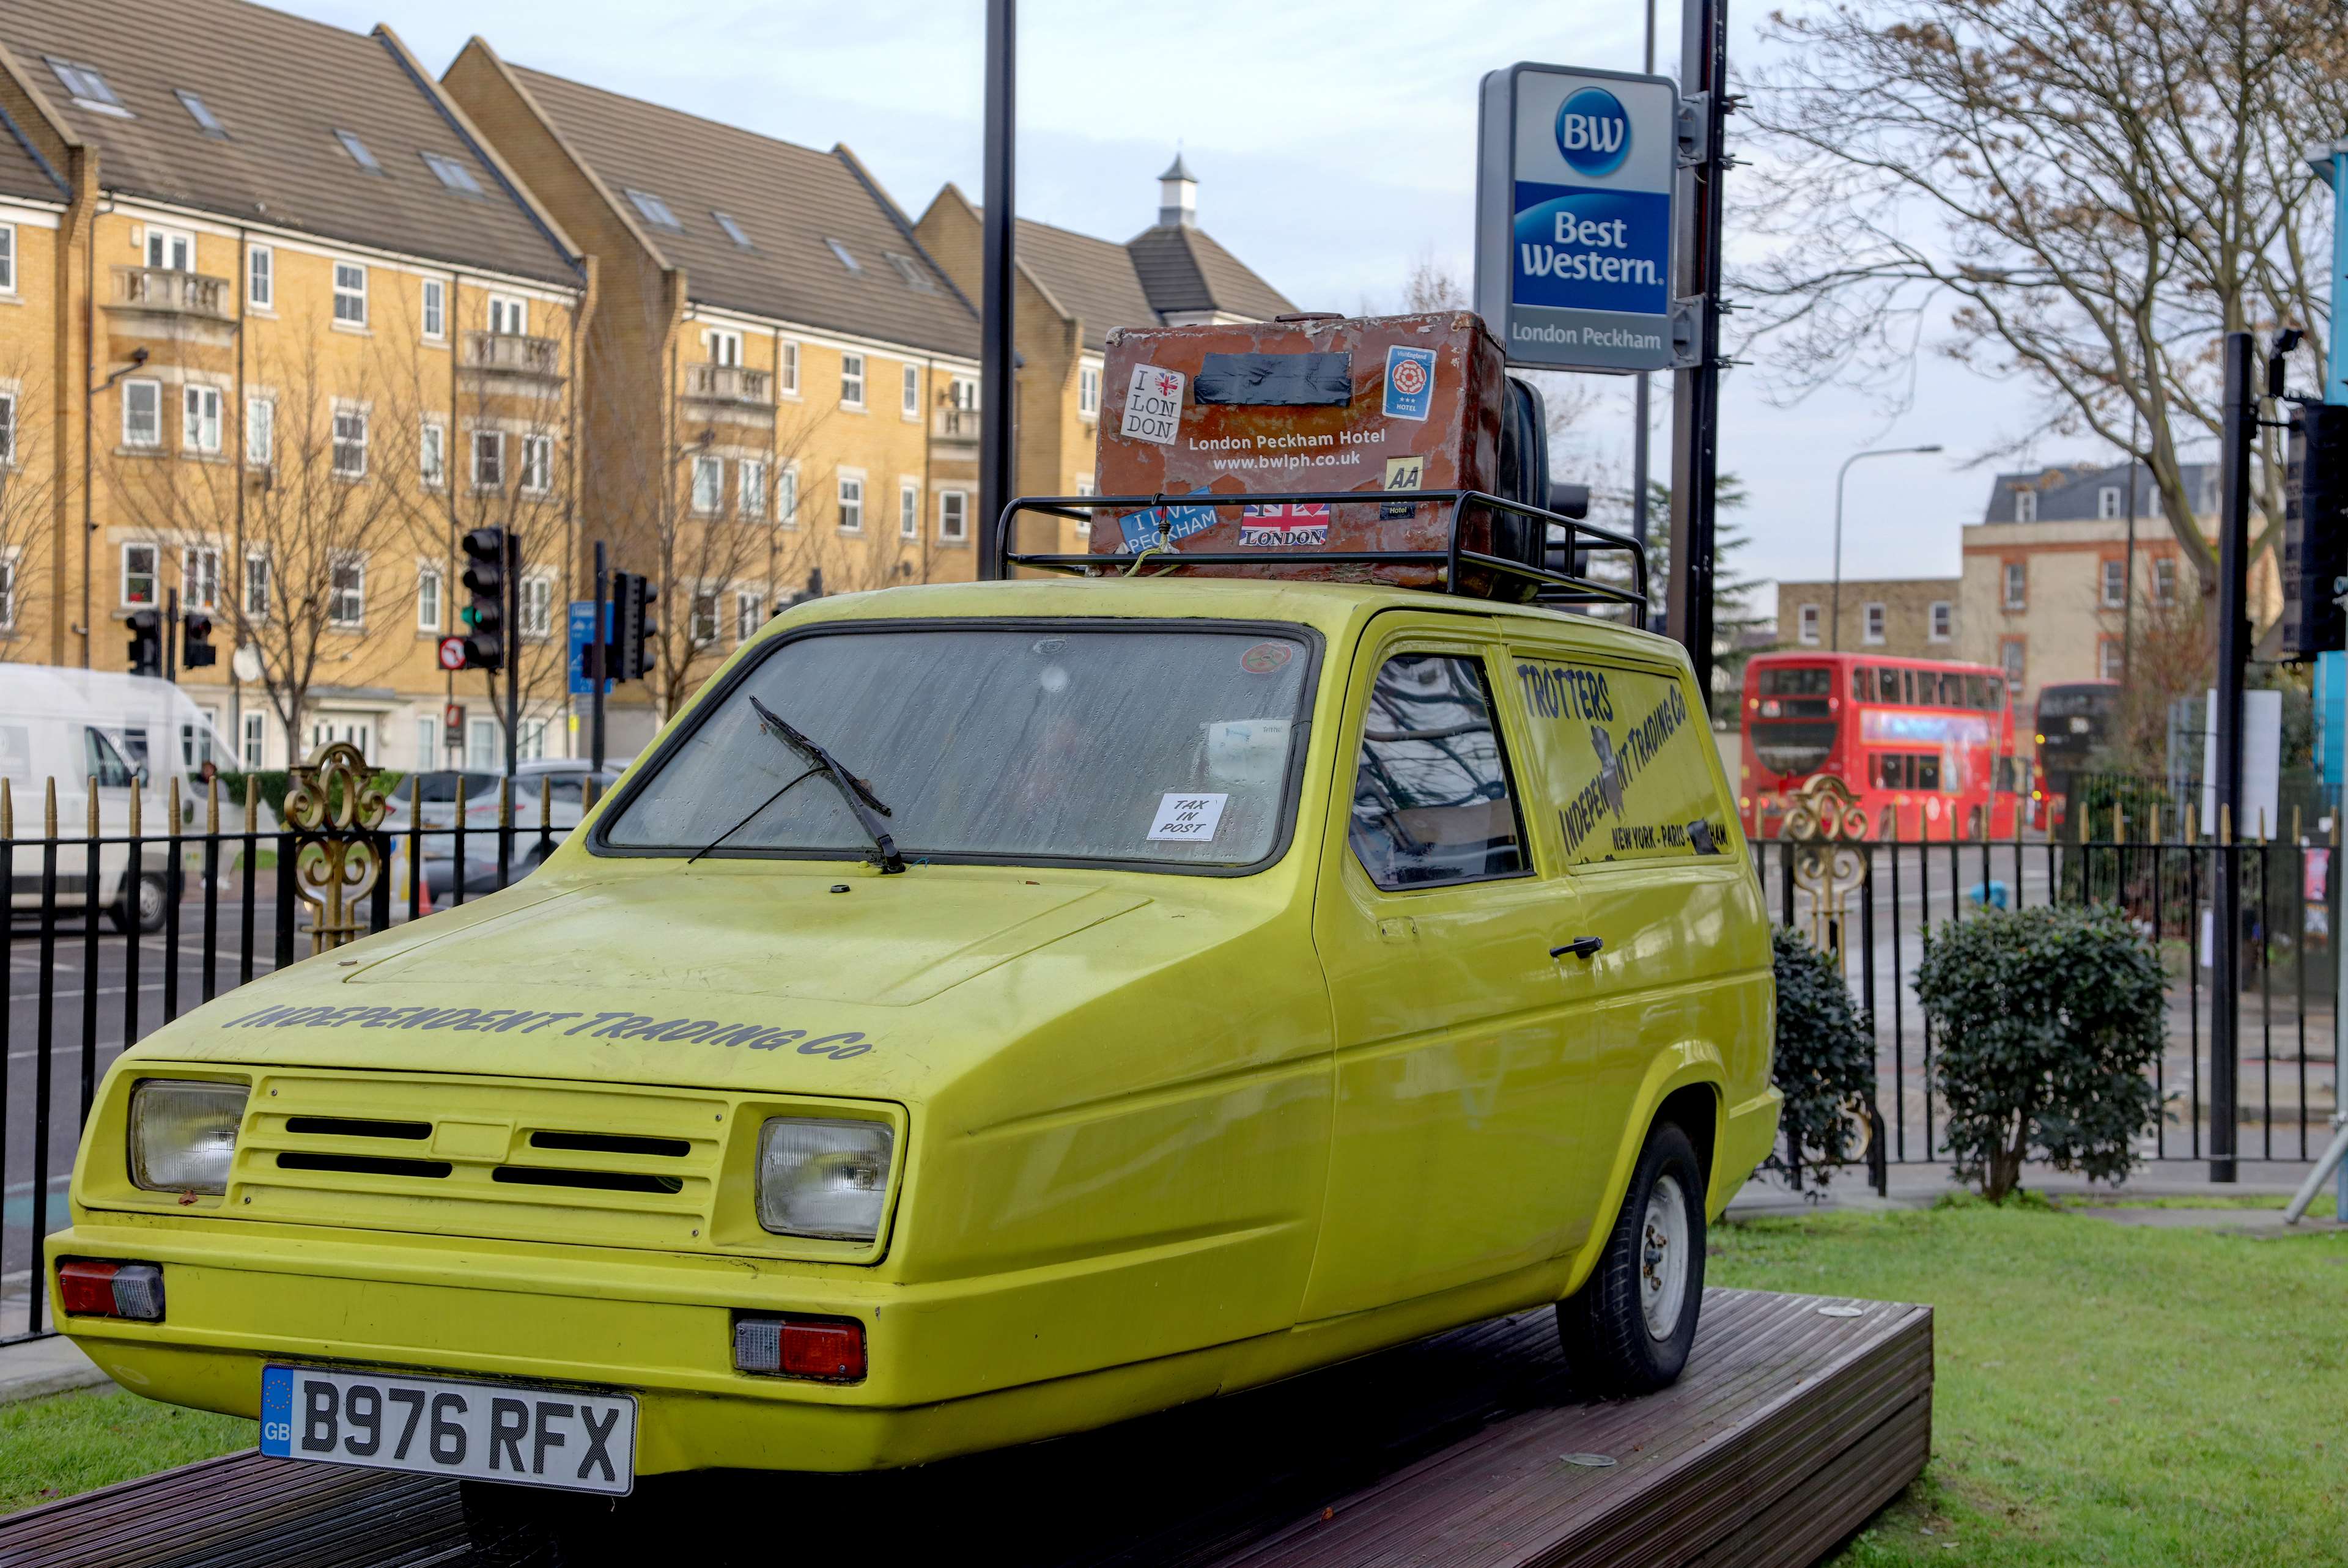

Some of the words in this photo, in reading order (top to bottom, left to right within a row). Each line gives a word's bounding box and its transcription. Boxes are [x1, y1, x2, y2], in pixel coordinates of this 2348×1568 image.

[1563, 113, 1625, 153] BW
[1555, 211, 1628, 249] Best
[1513, 322, 1578, 345] London
[1583, 327, 1661, 350] Peckham
[1397, 350, 1427, 359] VisitEngland
[1134, 370, 1148, 391] I
[1131, 394, 1177, 418] LON
[1127, 414, 1173, 439] DON
[1189, 436, 1252, 451] London
[1257, 433, 1334, 449] Peckham
[1340, 428, 1386, 444] Hotel
[1213, 451, 1360, 470] www.bwlph.co.uk
[1387, 466, 1419, 489] AA
[1134, 514, 1145, 531] I
[1244, 530, 1323, 545] LONDON
[1517, 664, 1613, 722] TROTTERS
[1559, 742, 1633, 856] INDEPENNT
[1628, 699, 1675, 773] TRADING
[1670, 684, 1686, 726] Co
[1174, 800, 1209, 809] TAX
[1159, 823, 1207, 833] POST
[1175, 812, 1199, 821] IN
[1611, 826, 1632, 851] NEW
[1631, 825, 1656, 849] YORK
[1661, 825, 1686, 847] PARIS
[221, 1004, 583, 1033] INDEPENDENT
[563, 1012, 807, 1051] TRADING
[796, 1032, 873, 1061] Co
[264, 1421, 290, 1441] GB
[301, 1379, 468, 1466] B976
[489, 1396, 620, 1482] RFX
